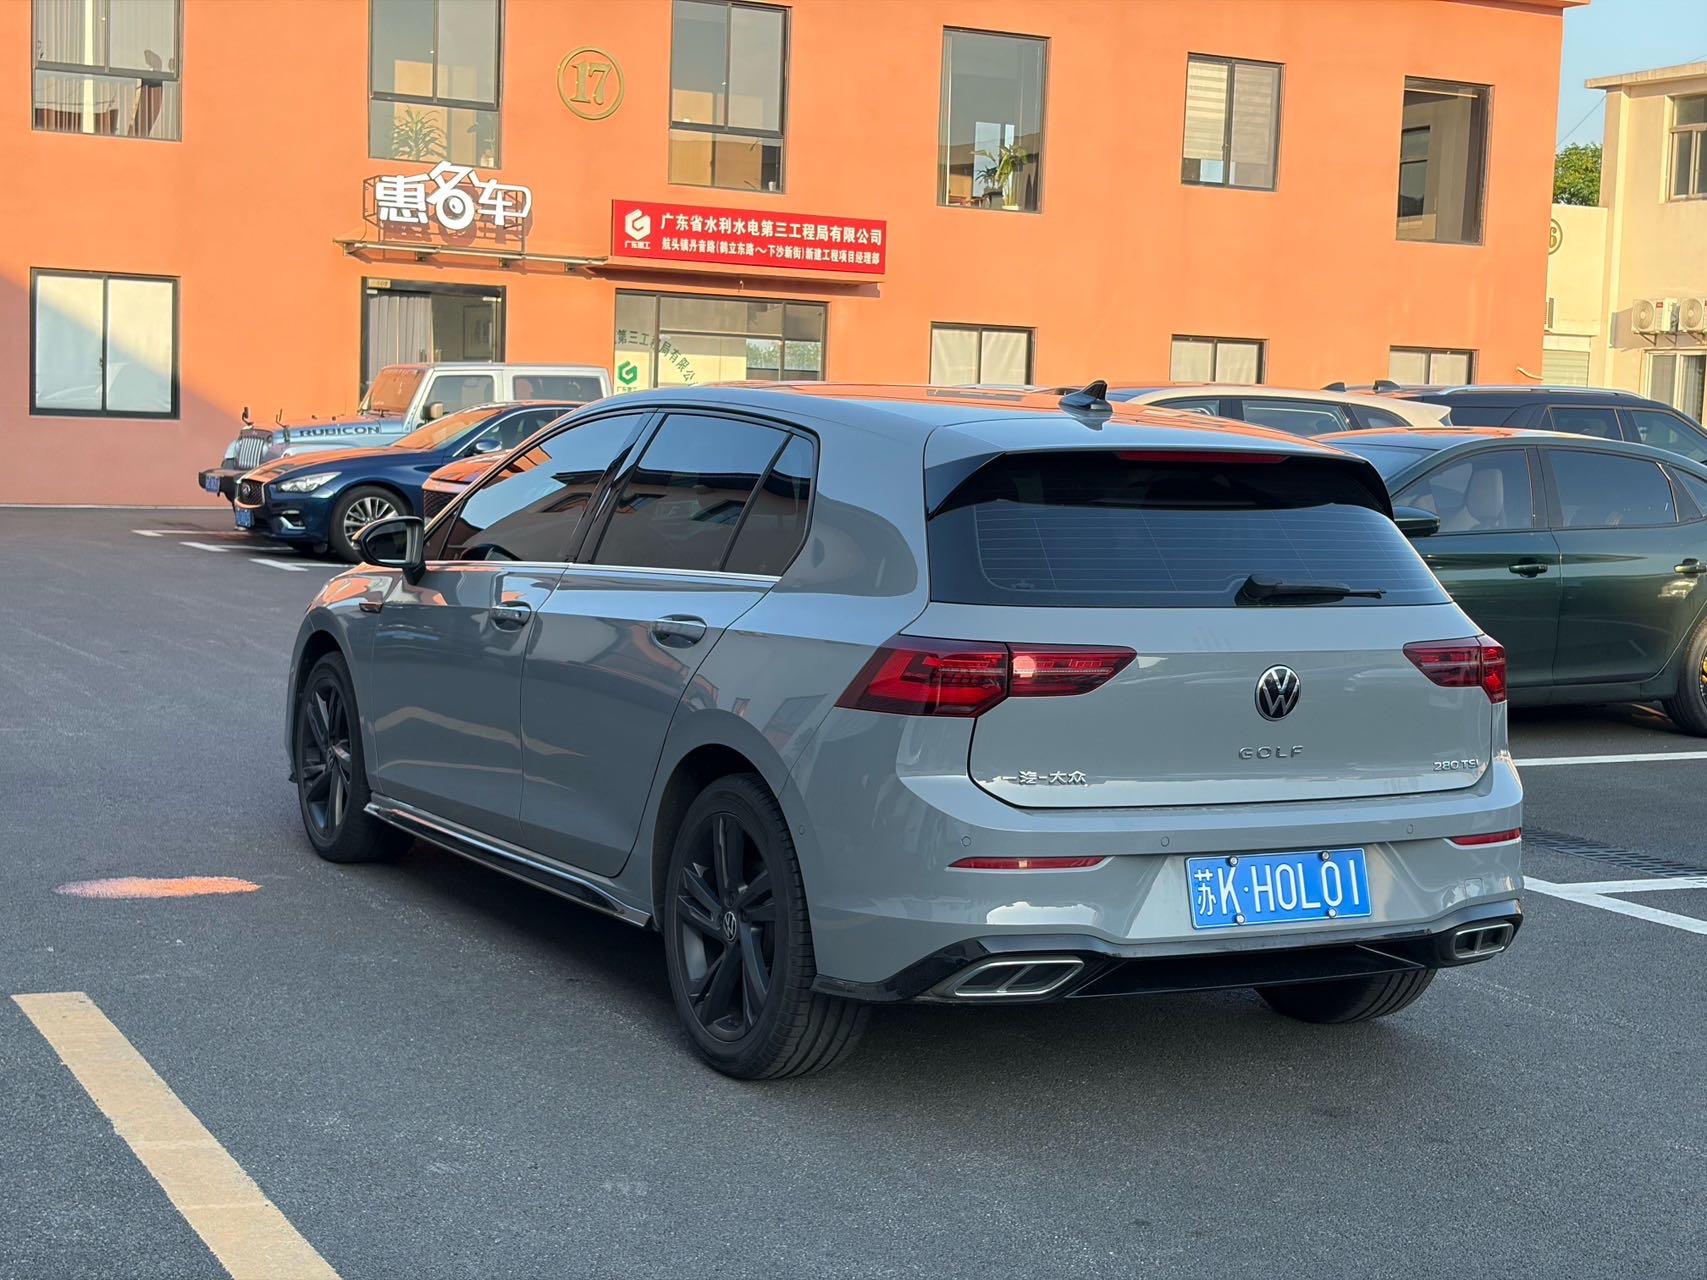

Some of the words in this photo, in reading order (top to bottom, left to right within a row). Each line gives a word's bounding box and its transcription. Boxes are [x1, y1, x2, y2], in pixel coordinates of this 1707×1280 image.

[570, 61, 612, 105] 17
[660, 212, 883, 246] 广东省水利水电第三工程局有限公司
[299, 426, 380, 437] RUBICON
[1238, 745, 1304, 760] GOLF
[1433, 760, 1459, 771] 280
